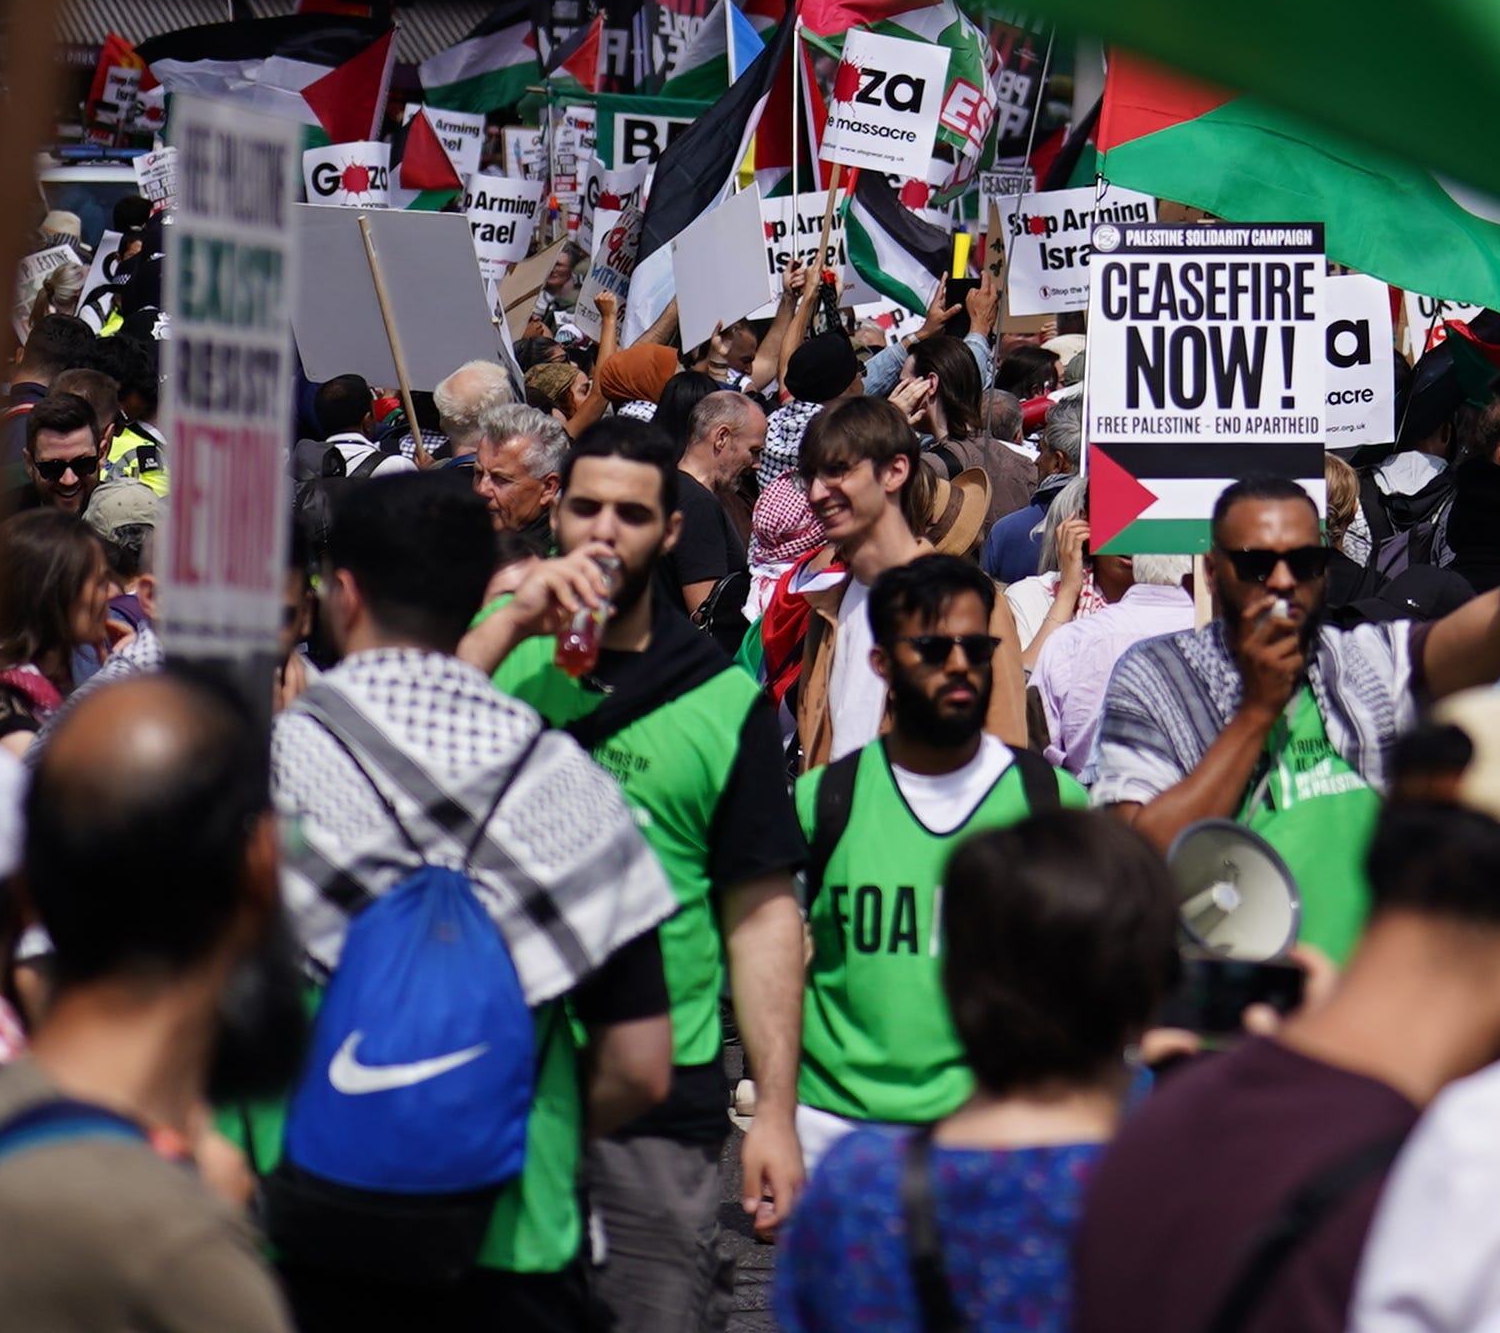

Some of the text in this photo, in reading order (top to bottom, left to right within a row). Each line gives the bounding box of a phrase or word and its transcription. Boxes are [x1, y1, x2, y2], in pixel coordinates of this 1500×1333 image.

[435, 118, 480, 138] Arming
[836, 117, 917, 144] massacre
[475, 190, 536, 218] Arming
[1063, 201, 1149, 232] Arming
[471, 220, 516, 245] rael
[1125, 228, 1313, 247] PALESTINE SOLIDARITY CAMPAIGN
[1040, 242, 1092, 271] Isra
[1101, 261, 1316, 322] CEASEFIRE
[1126, 325, 1296, 410] NOW!
[1097, 416, 1128, 435] FREE
[1132, 416, 1201, 435] PALESTINE
[1215, 416, 1242, 435] END
[1245, 416, 1319, 435] APARTHEID
